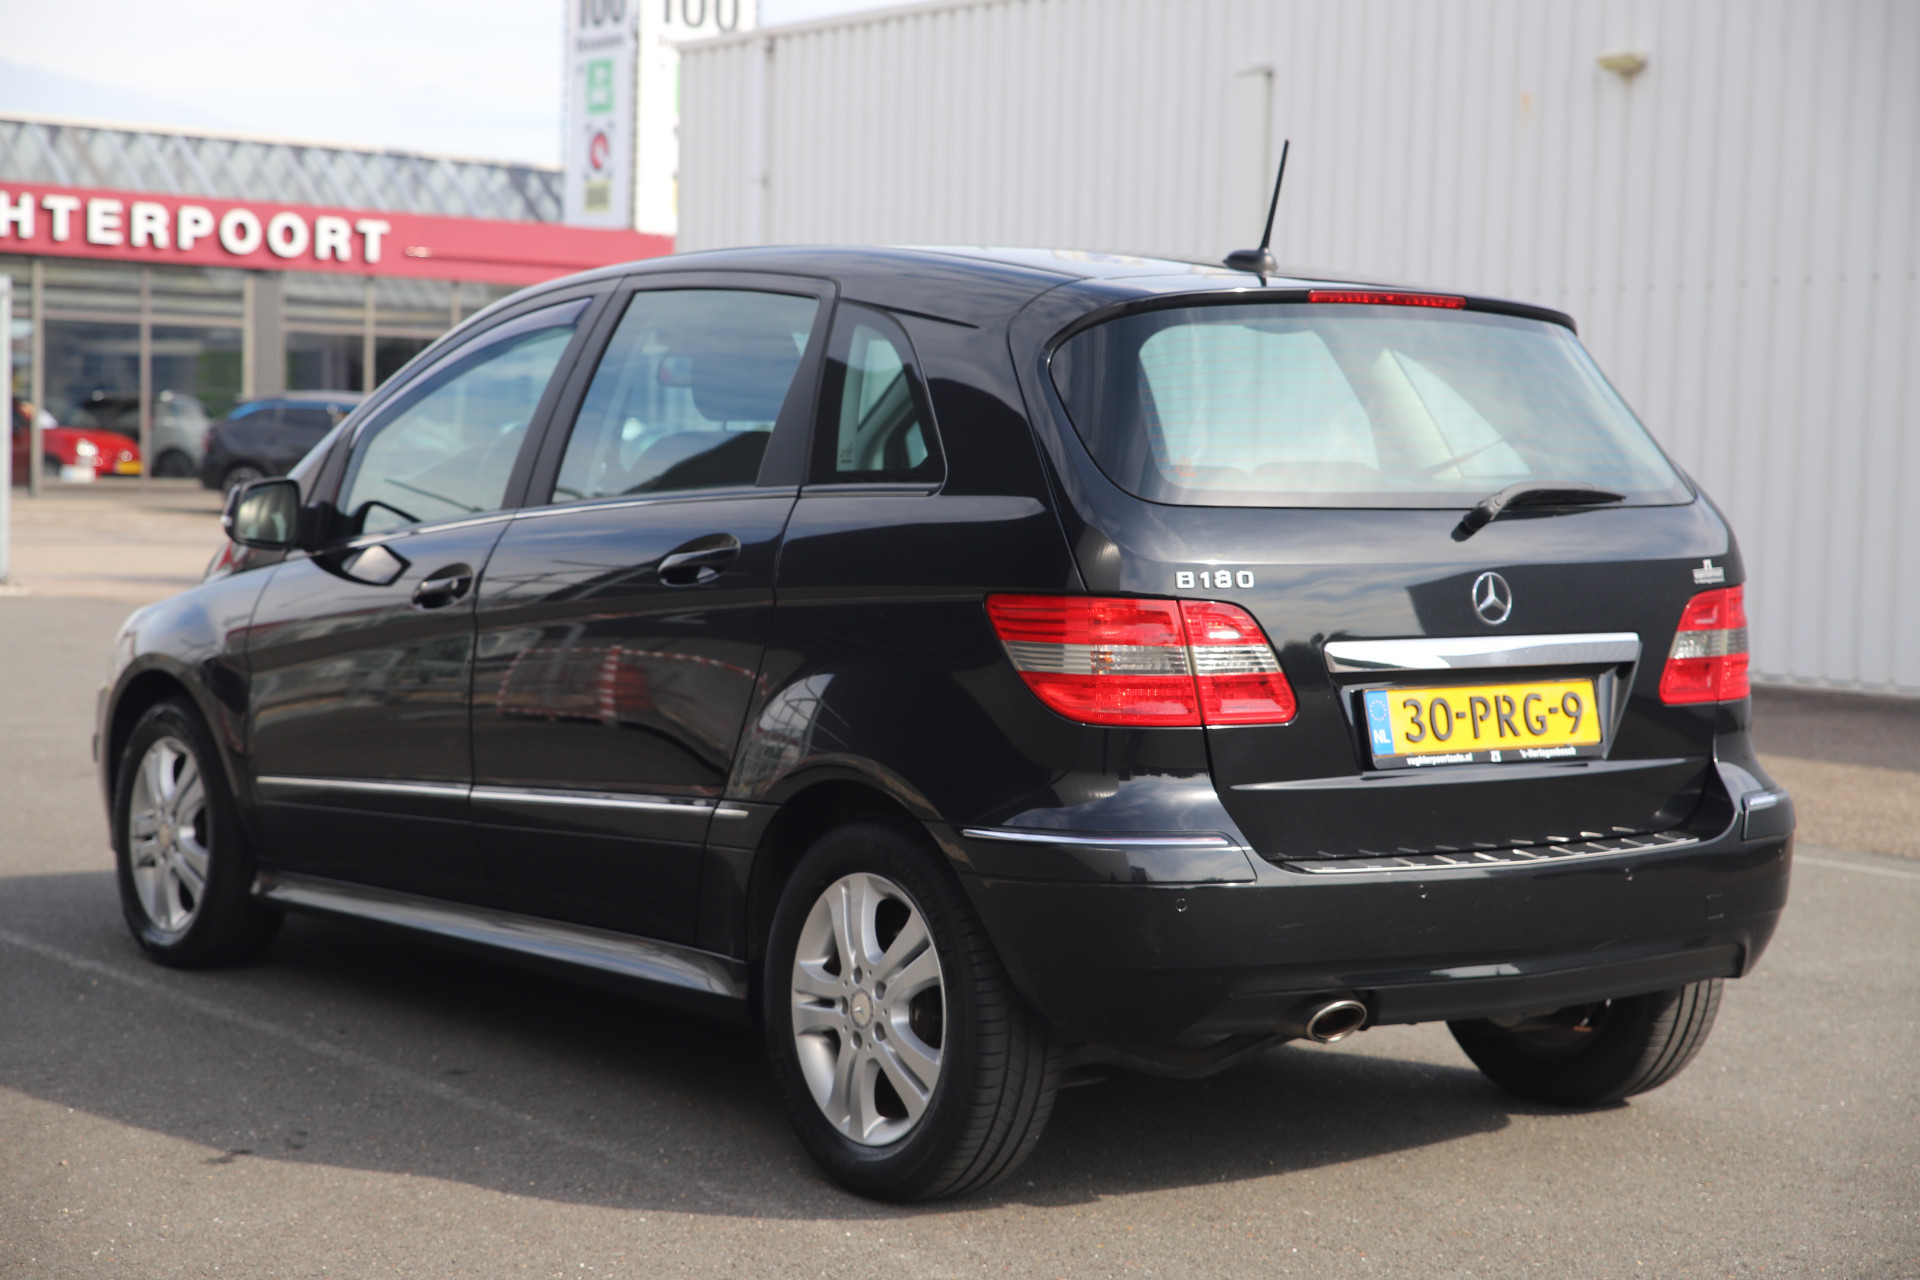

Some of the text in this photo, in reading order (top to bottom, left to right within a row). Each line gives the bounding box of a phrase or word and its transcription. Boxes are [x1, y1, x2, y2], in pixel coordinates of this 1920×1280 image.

[0, 190, 391, 264] HTERPOORT
[1175, 569, 1255, 589] B180
[1403, 691, 1583, 743] 30-PRG-9
[1373, 729, 1391, 744] NL
